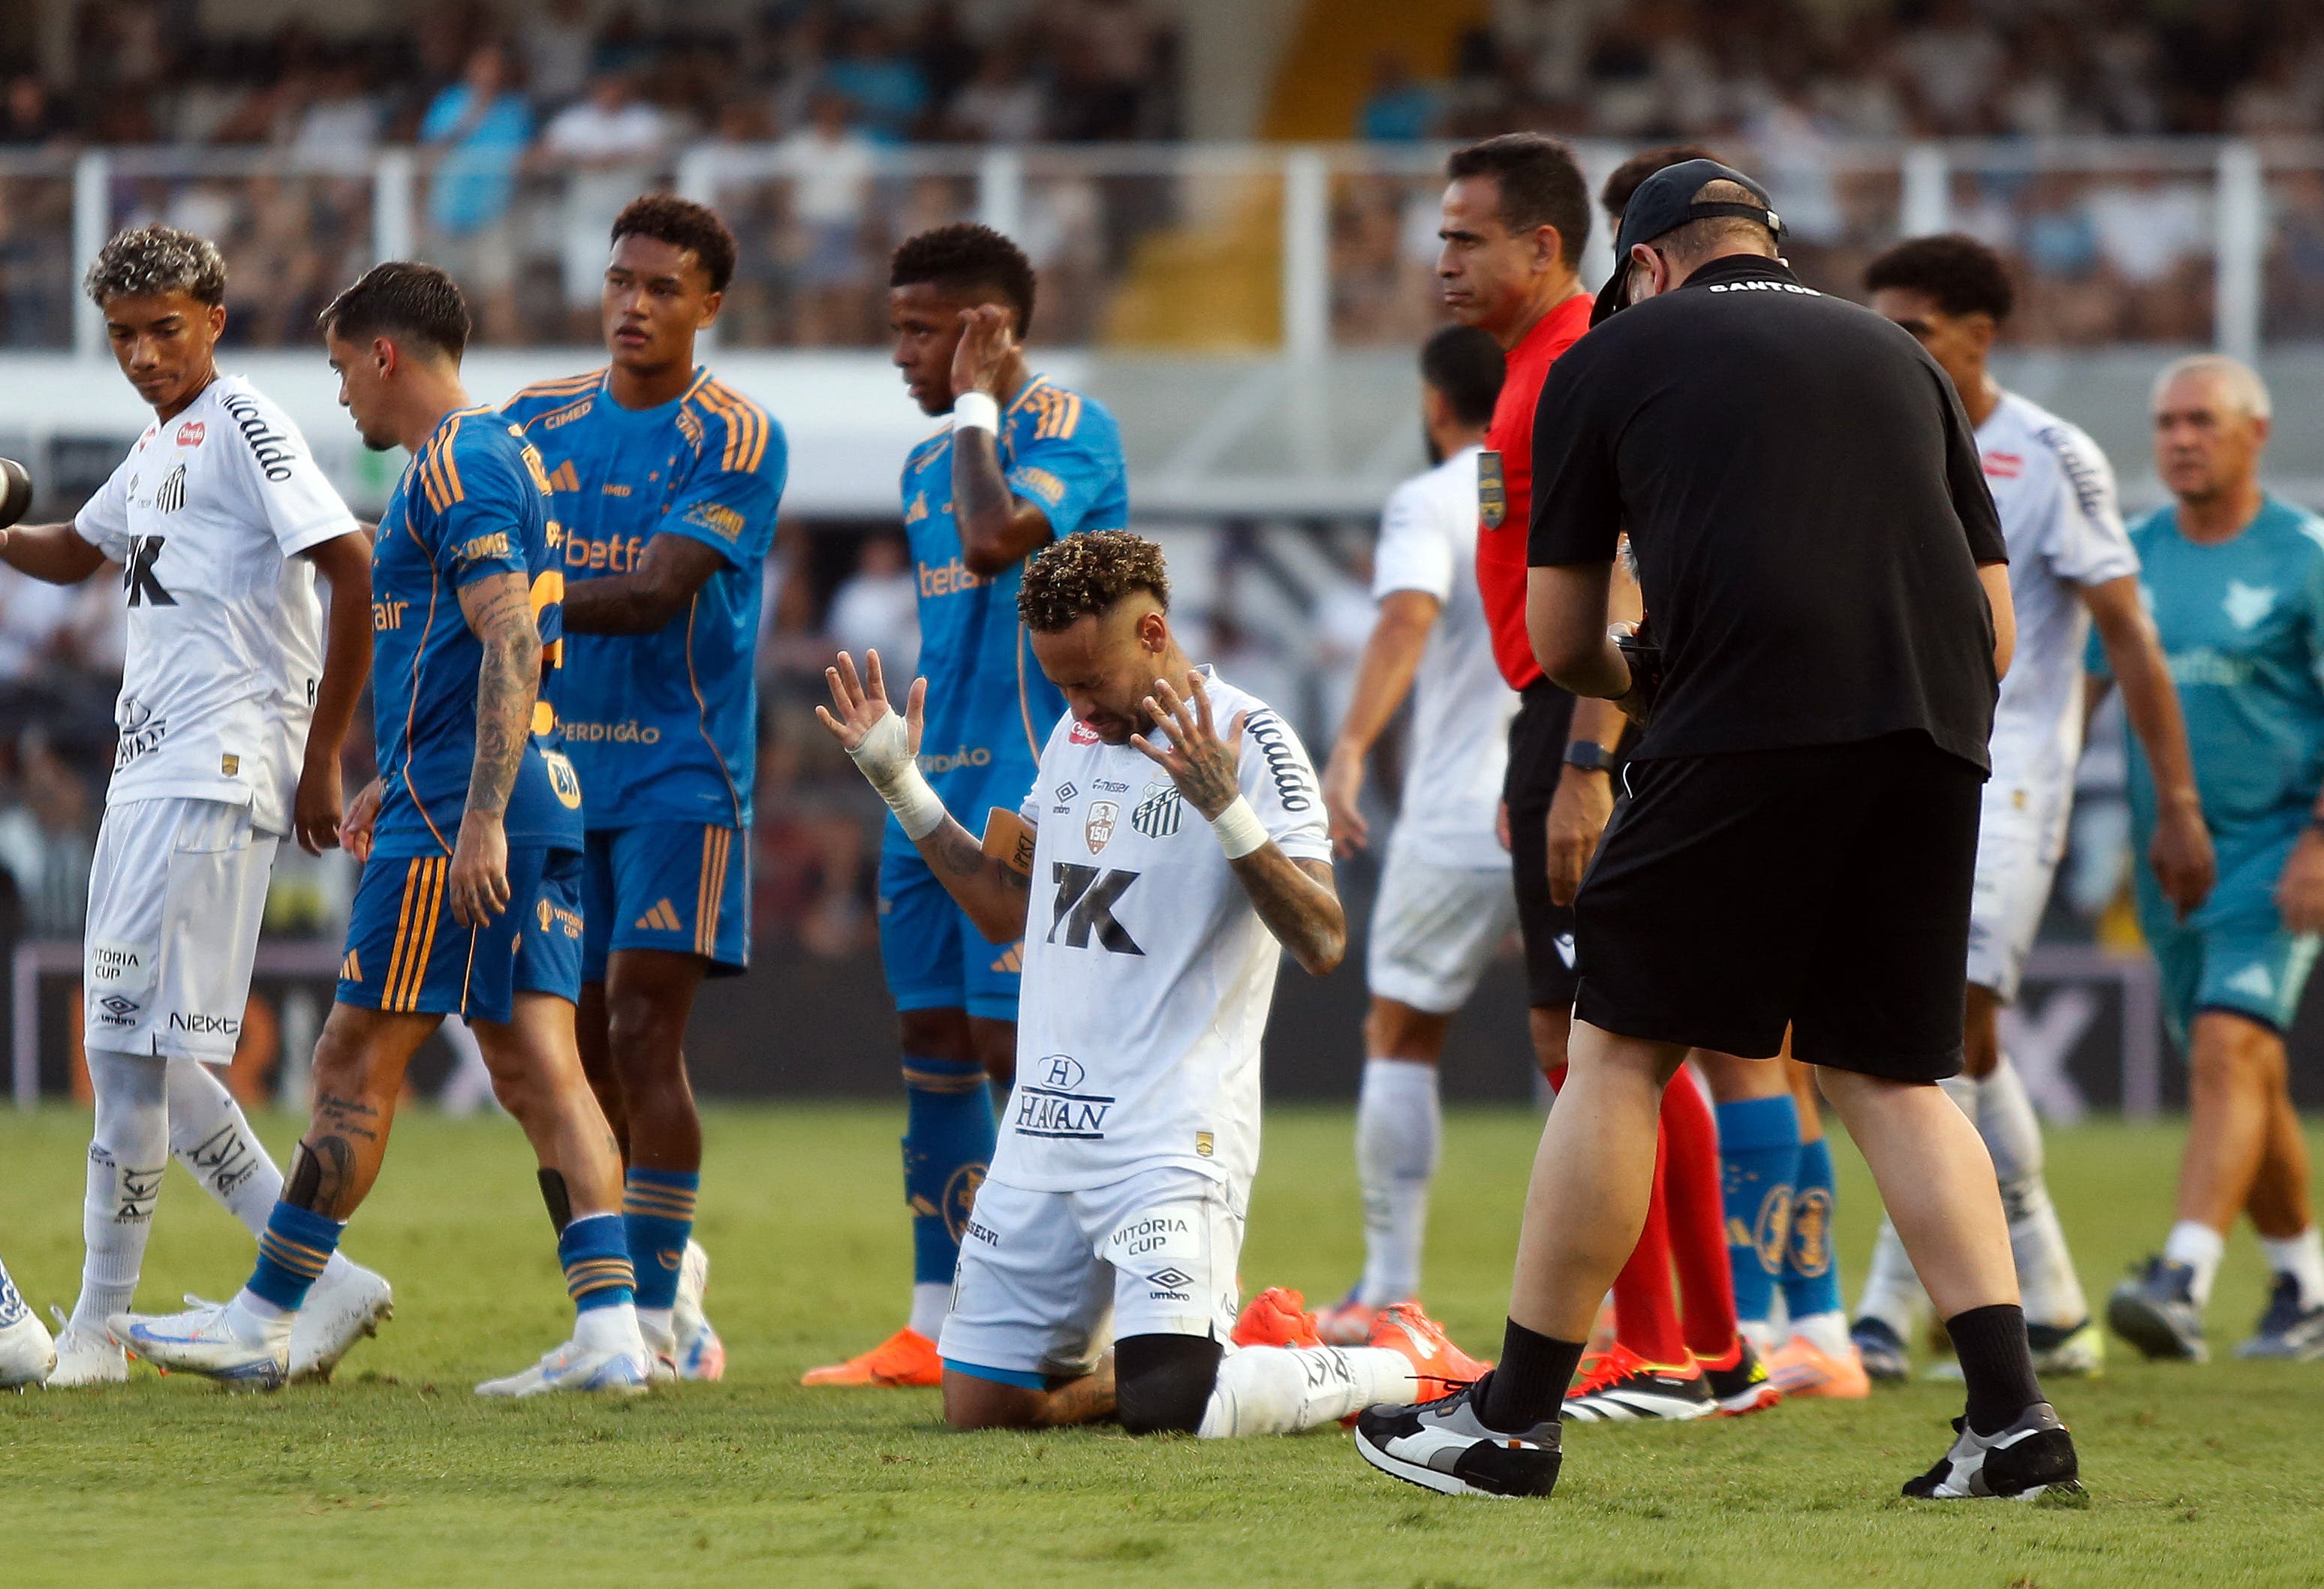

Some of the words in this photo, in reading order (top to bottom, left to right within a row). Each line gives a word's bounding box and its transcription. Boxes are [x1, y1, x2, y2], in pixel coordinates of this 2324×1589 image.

[544, 401, 593, 430] CIMED
[565, 528, 645, 573] betf
[372, 591, 410, 632] air
[1089, 826, 1109, 843] 150
[1046, 861, 1146, 956] 7K
[95, 965, 121, 981] CUP
[1016, 1094, 1112, 1131] HAVAN
[1112, 1217, 1189, 1247] VITÓRIA
[1128, 1236, 1167, 1256] CUP
[1149, 1290, 1191, 1302] umbro
